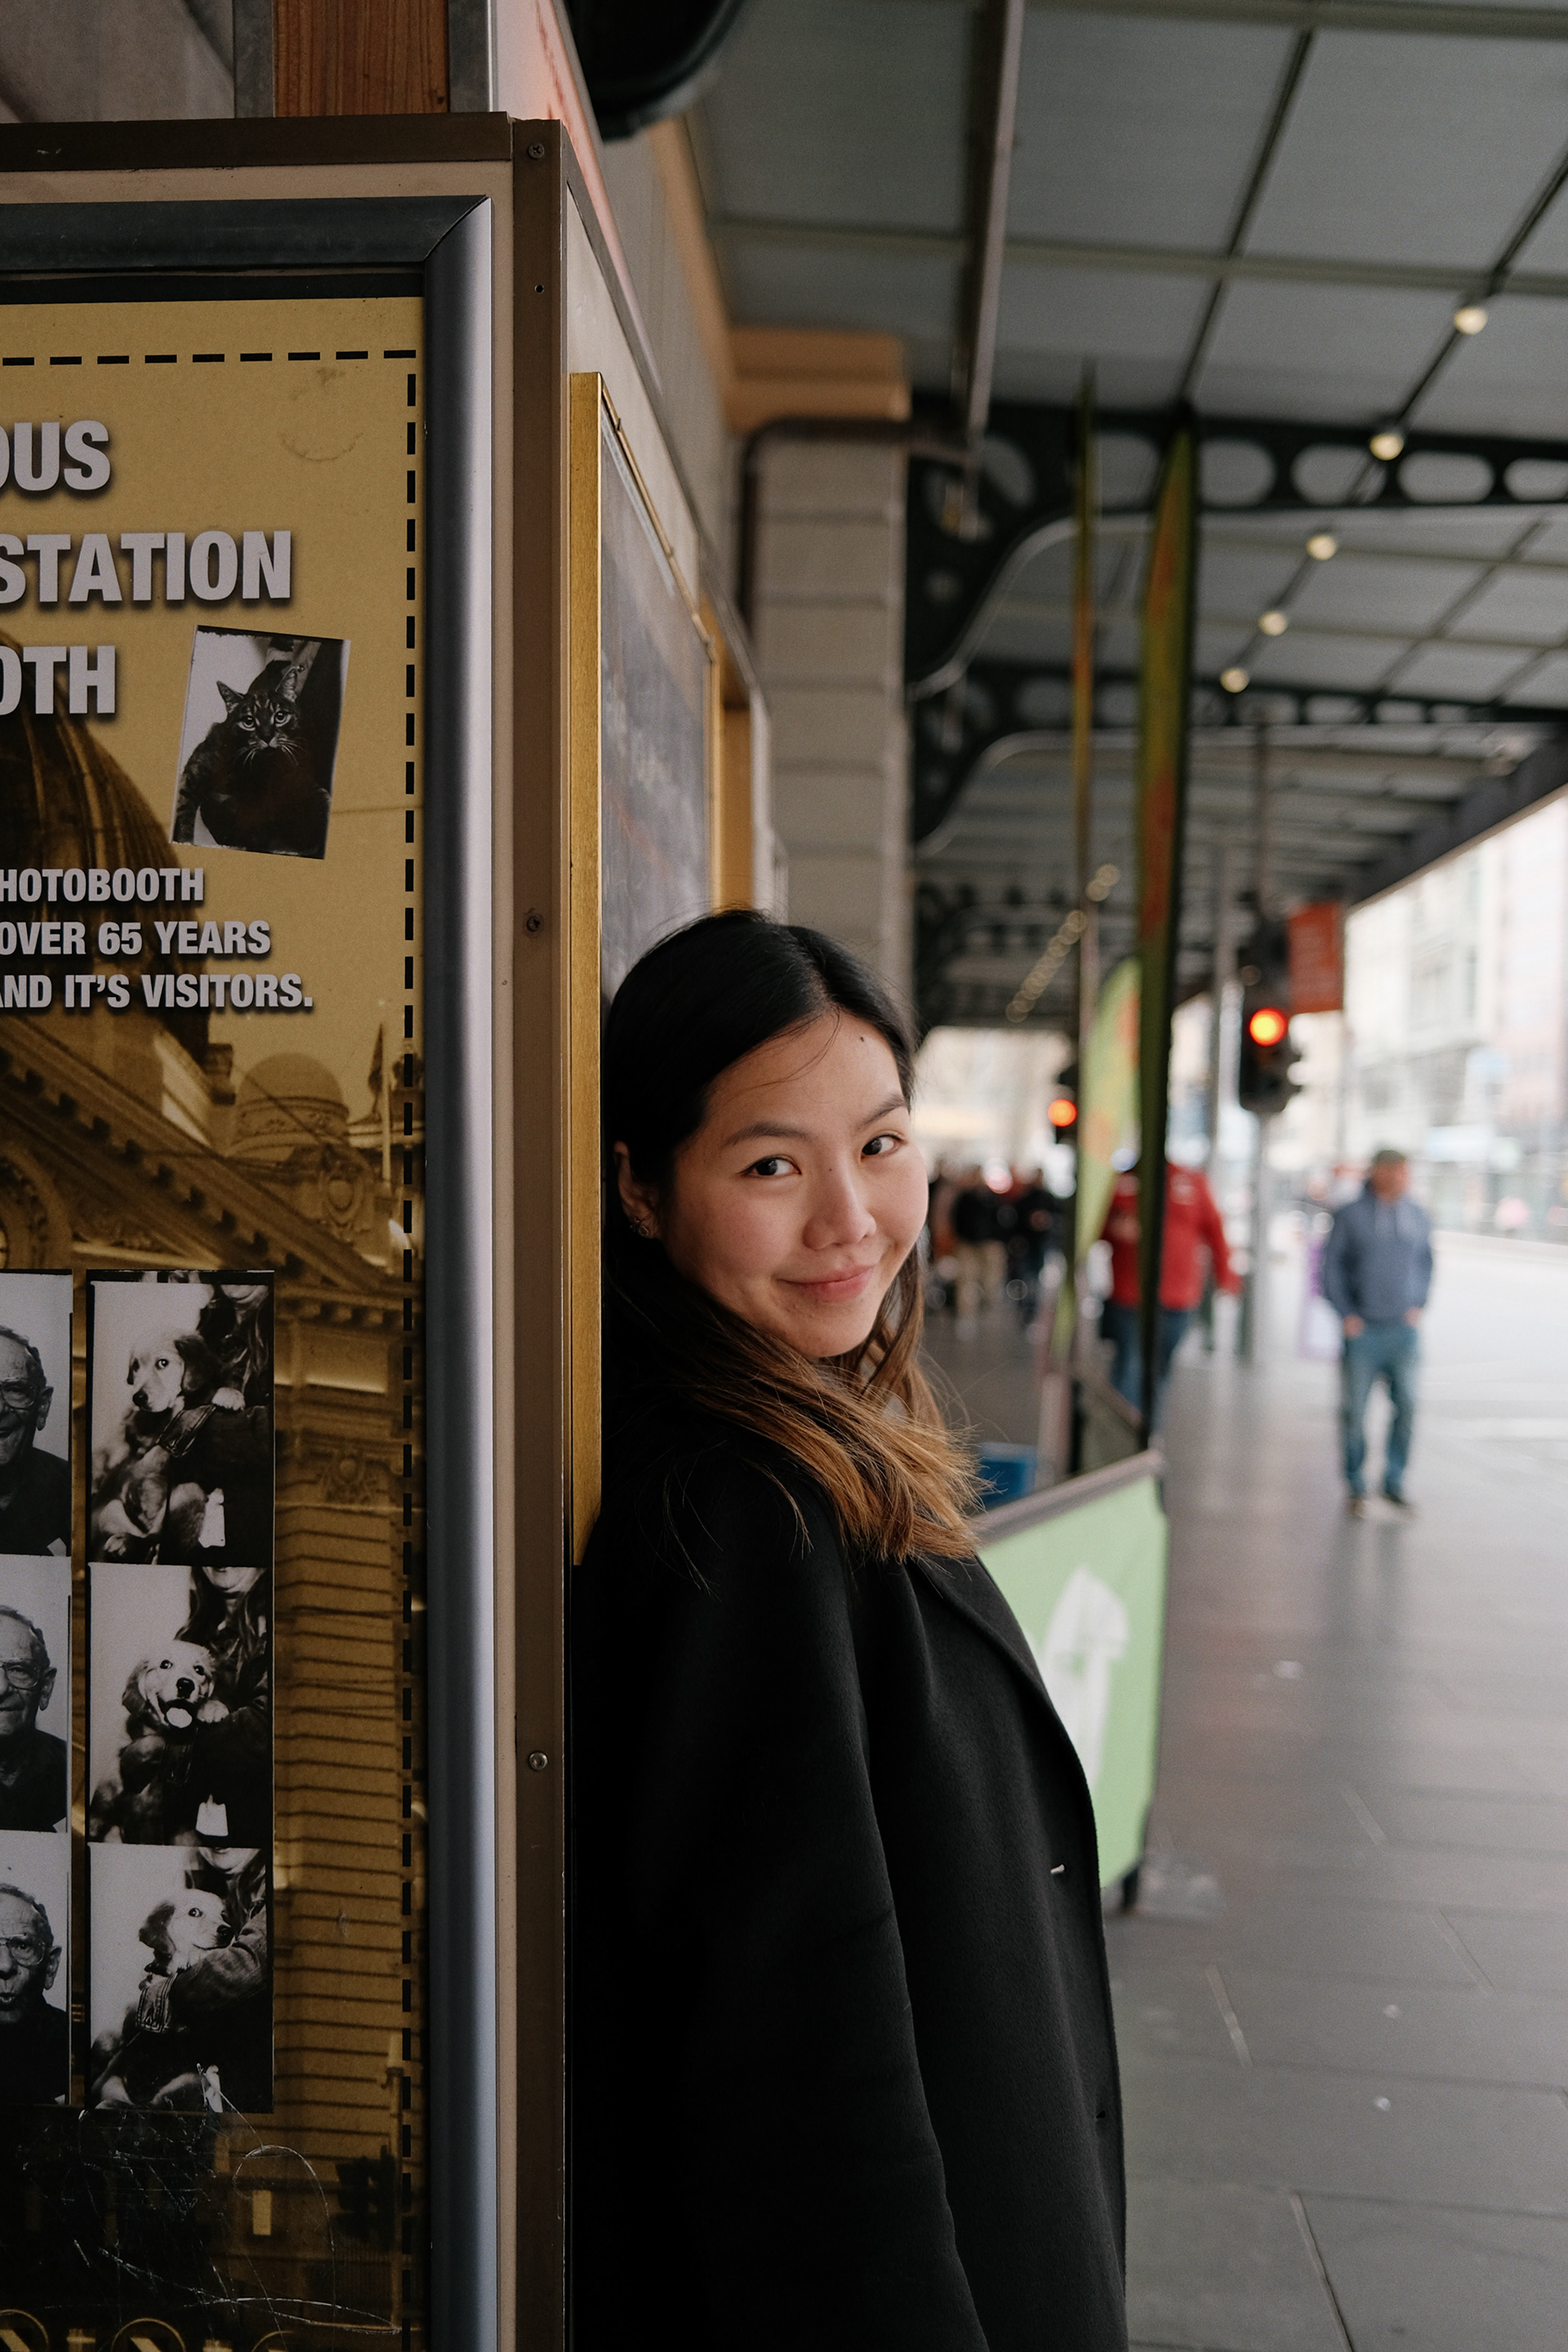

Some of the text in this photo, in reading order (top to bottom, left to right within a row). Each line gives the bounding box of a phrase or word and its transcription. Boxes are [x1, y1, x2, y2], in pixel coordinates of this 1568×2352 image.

[0, 420, 110, 491] US
[0, 867, 203, 902] HOTOBOOTH
[0, 920, 271, 956] OVER 65 YEARS
[0, 973, 313, 1008] ND IT'S VISITORS.
